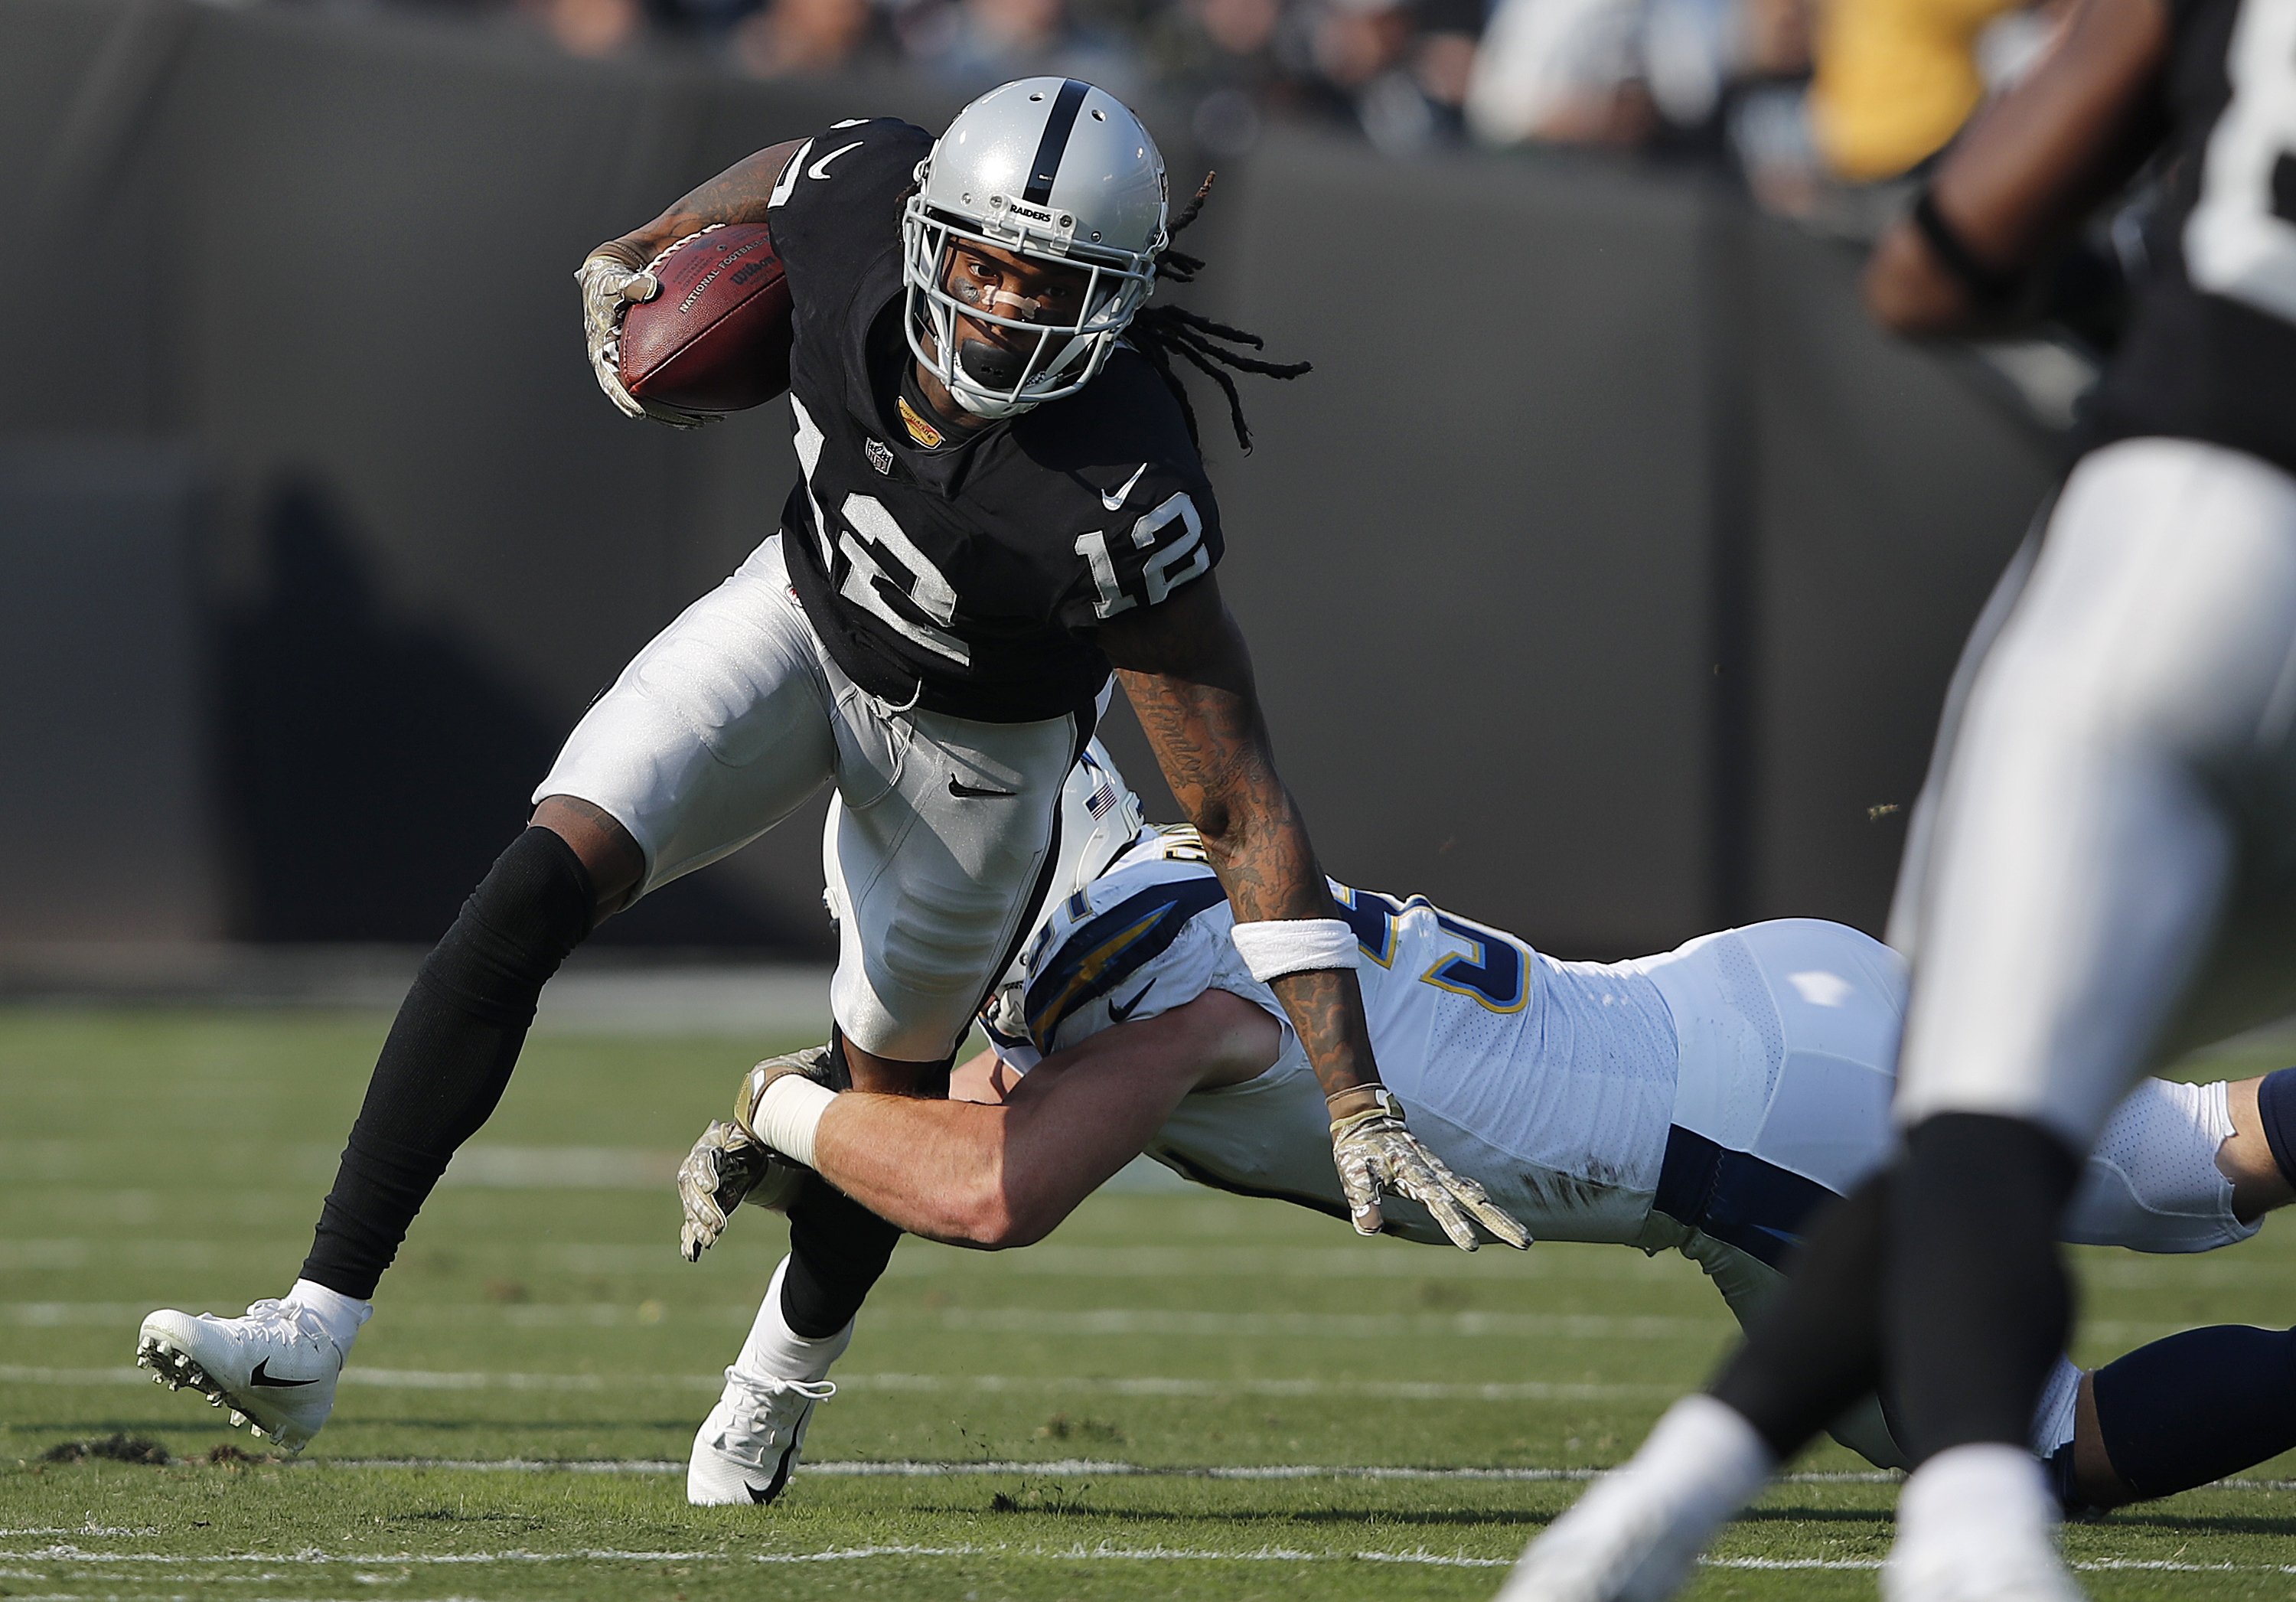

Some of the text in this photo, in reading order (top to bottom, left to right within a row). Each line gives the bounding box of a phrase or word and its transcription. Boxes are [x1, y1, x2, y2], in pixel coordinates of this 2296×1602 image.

[1010, 204, 1051, 222] RAIDERS
[679, 269, 720, 313] NATIONAL
[717, 239, 764, 269] FOOTBALL
[729, 255, 778, 285] Wilson
[1074, 491, 1211, 619] 12
